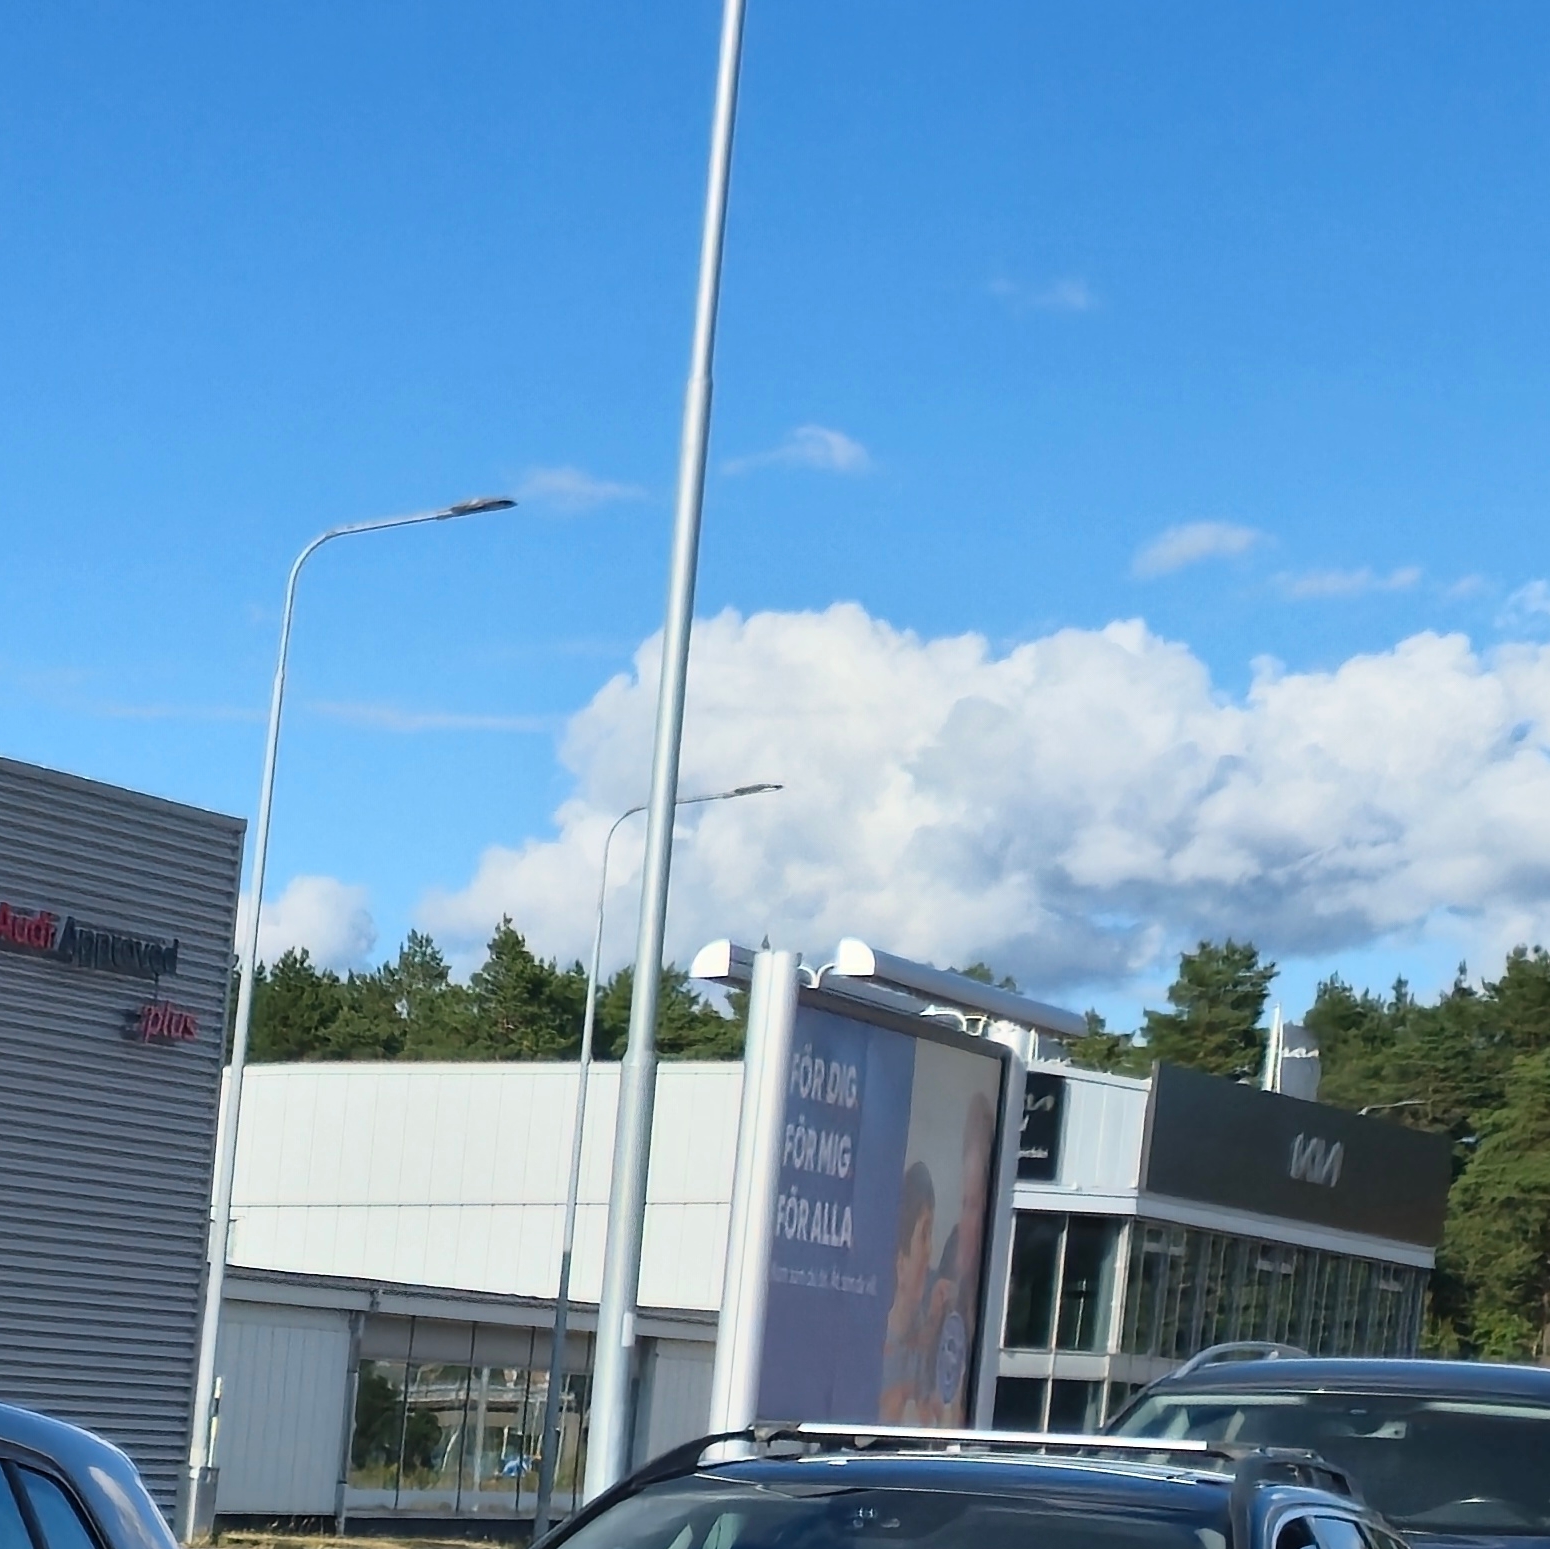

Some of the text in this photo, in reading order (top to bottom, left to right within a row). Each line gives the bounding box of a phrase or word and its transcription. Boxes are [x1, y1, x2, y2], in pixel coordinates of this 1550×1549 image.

[55, 915, 179, 976] Approved
[782, 1114, 818, 1173] FÖR
[775, 1185, 811, 1242] FÖR
